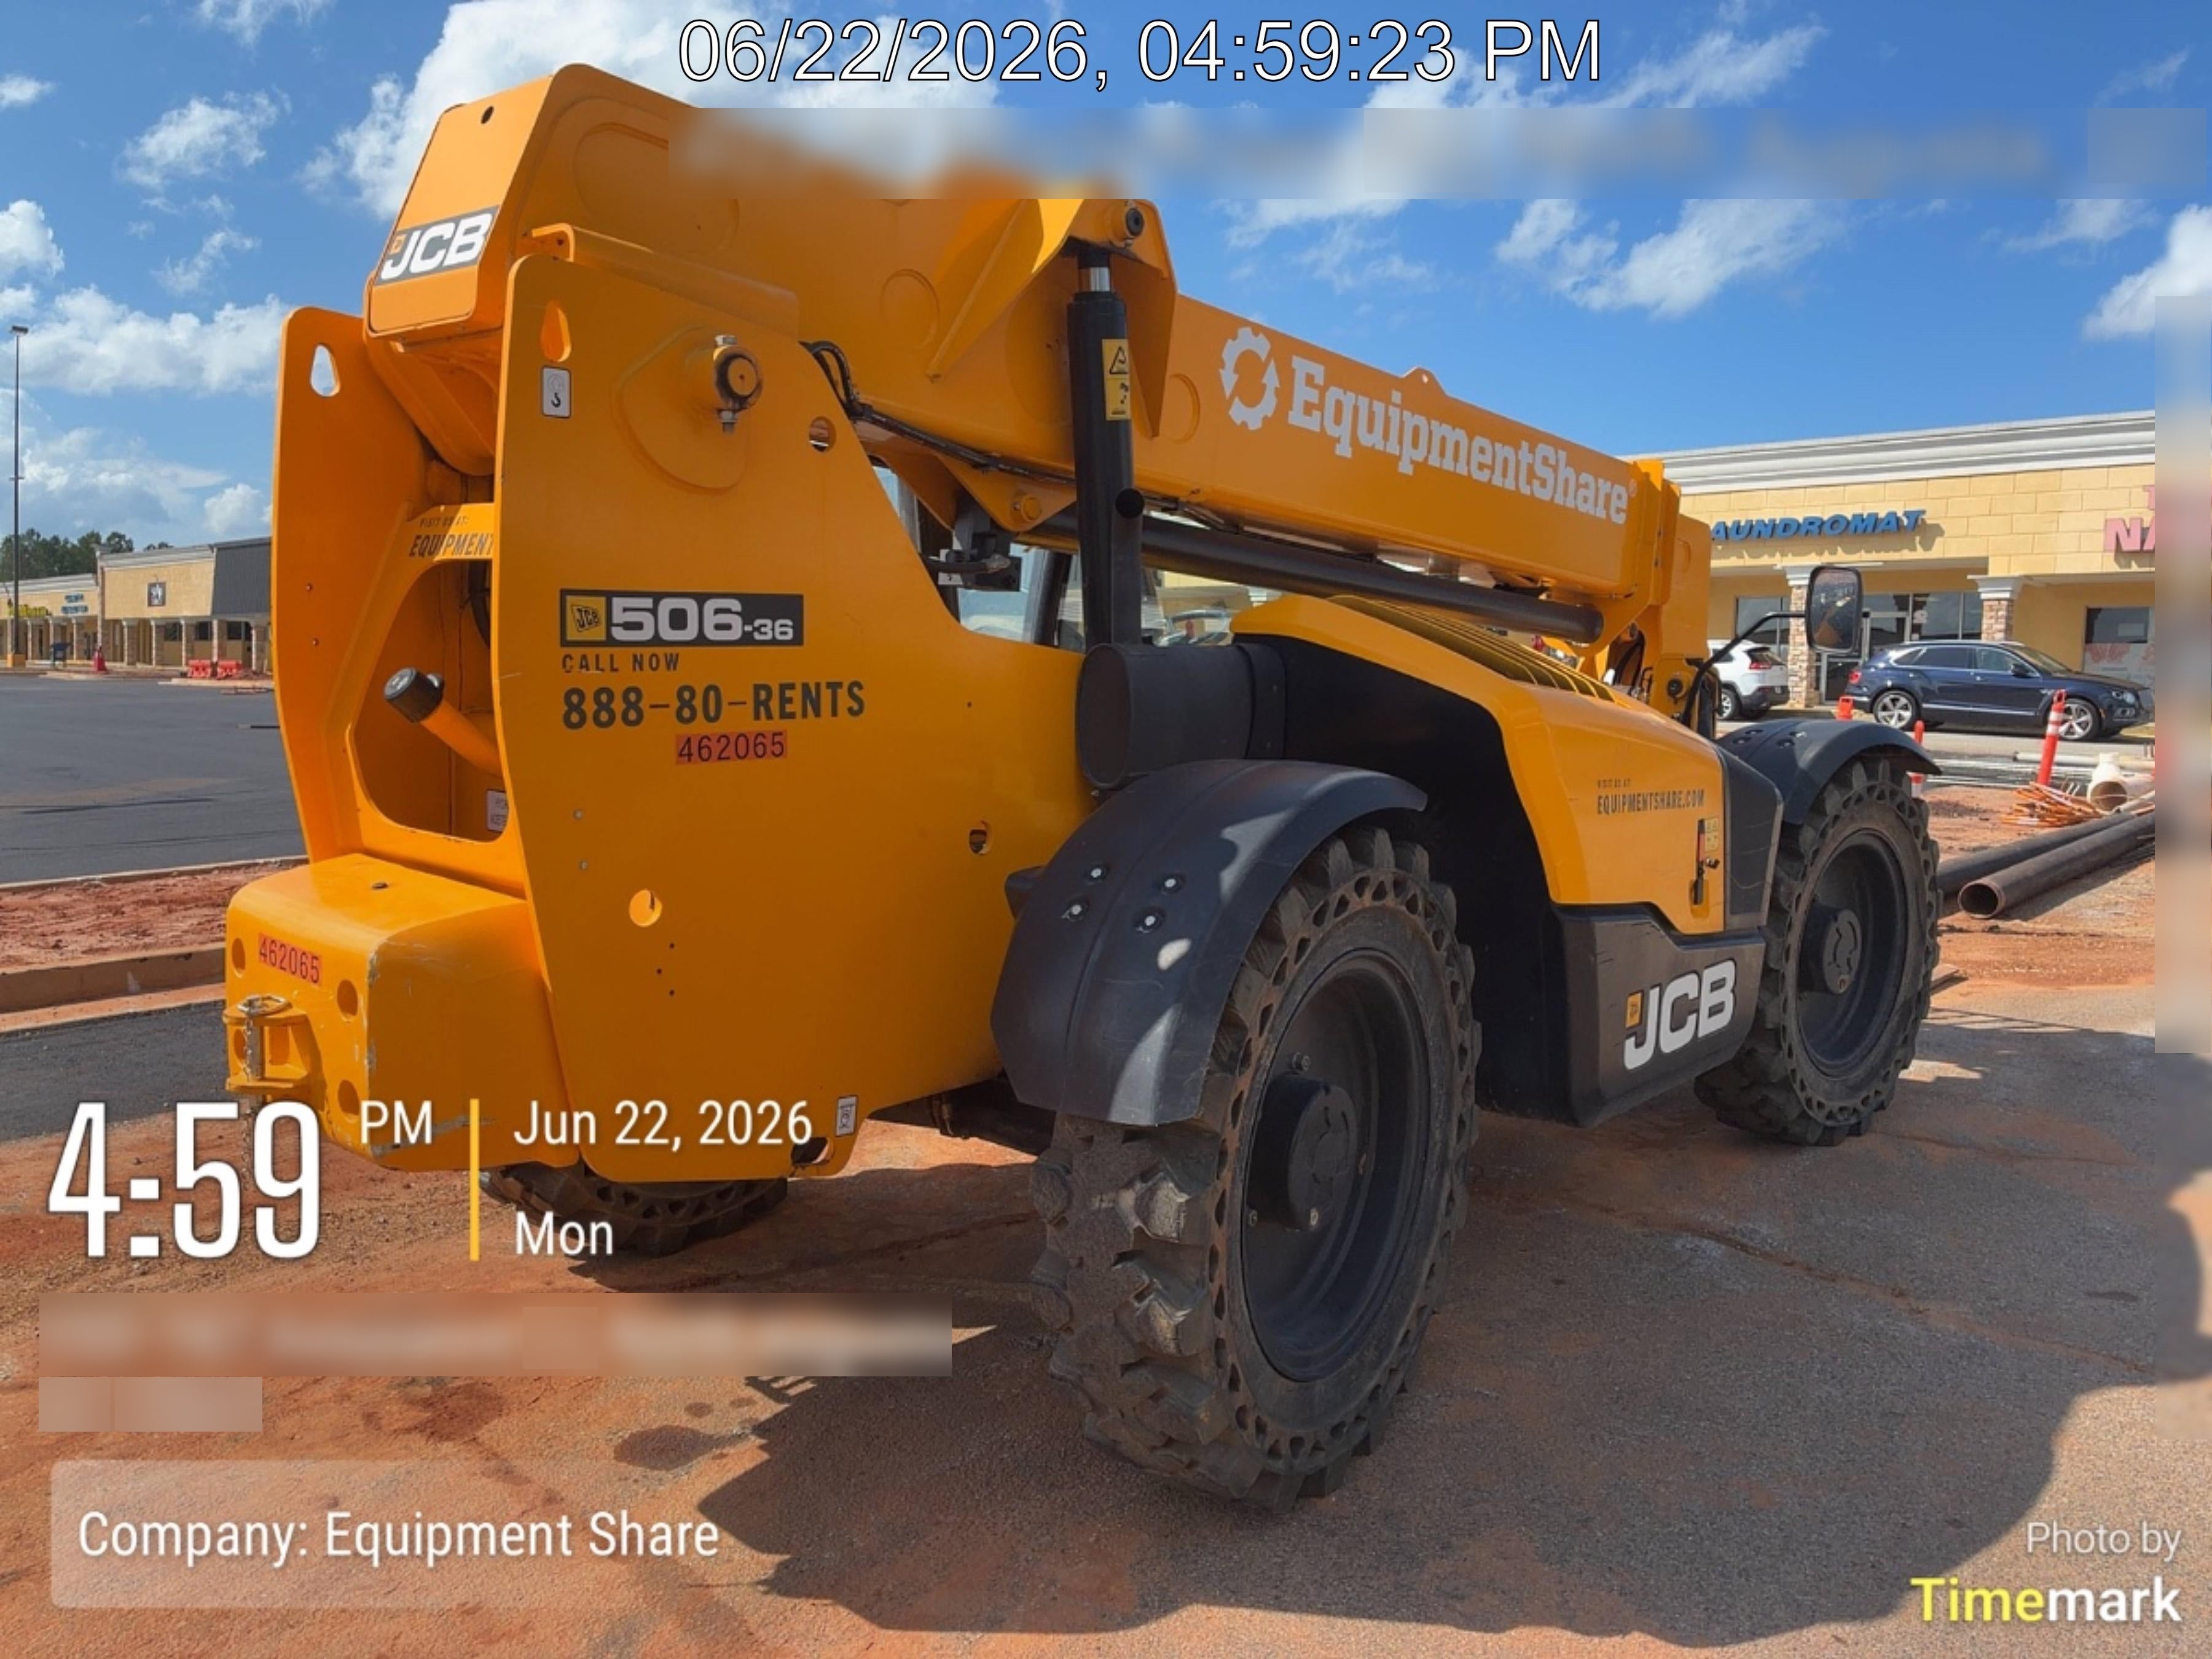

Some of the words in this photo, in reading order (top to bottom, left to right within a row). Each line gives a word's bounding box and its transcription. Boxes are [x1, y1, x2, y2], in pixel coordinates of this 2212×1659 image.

[381, 213, 493, 281] JCB
[1288, 355, 1630, 525] EquipmentShare
[611, 597, 794, 641] 506-36
[562, 653, 619, 673] CALL
[632, 653, 680, 672] NOW
[562, 680, 865, 730] 888-80-RENTS
[678, 731, 785, 763] 462065
[259, 938, 320, 983] 462065
[1623, 960, 1736, 1070] JCB
